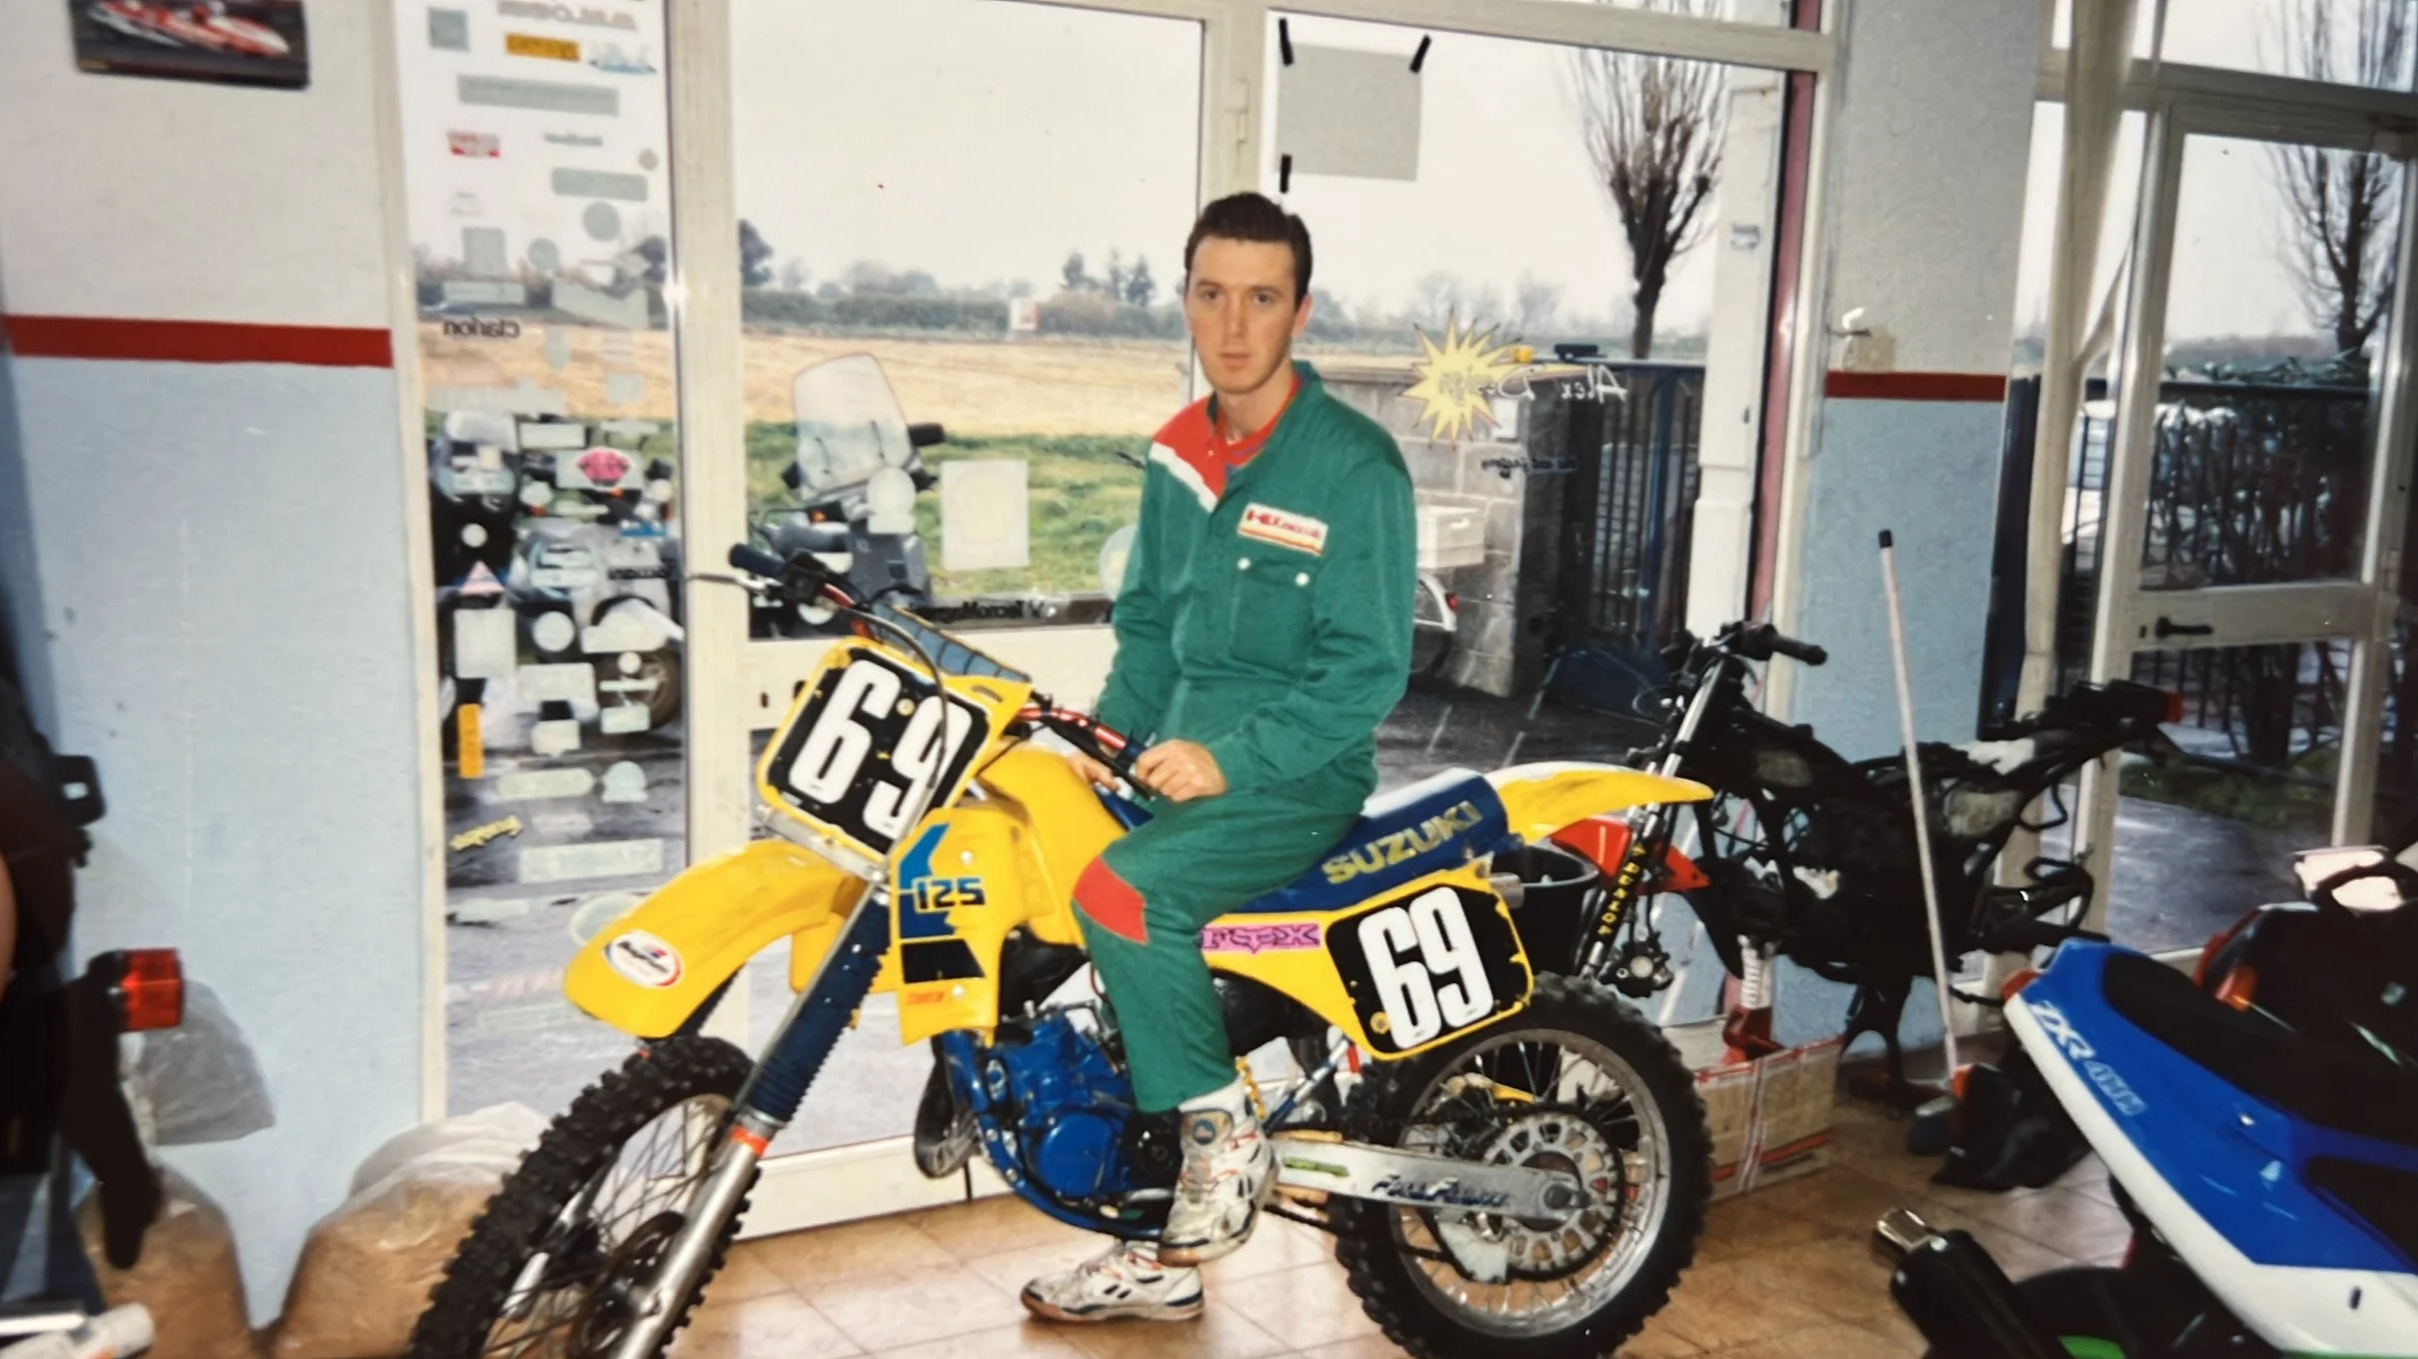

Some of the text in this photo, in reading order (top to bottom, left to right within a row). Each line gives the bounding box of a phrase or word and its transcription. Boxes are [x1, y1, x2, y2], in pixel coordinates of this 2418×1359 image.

[788, 659, 972, 841] 69
[1321, 800, 1483, 885] SUZUKI
[917, 877, 986, 909] 125
[1358, 886, 1494, 1049] 69
[2028, 1000, 2096, 1060] ZXR
